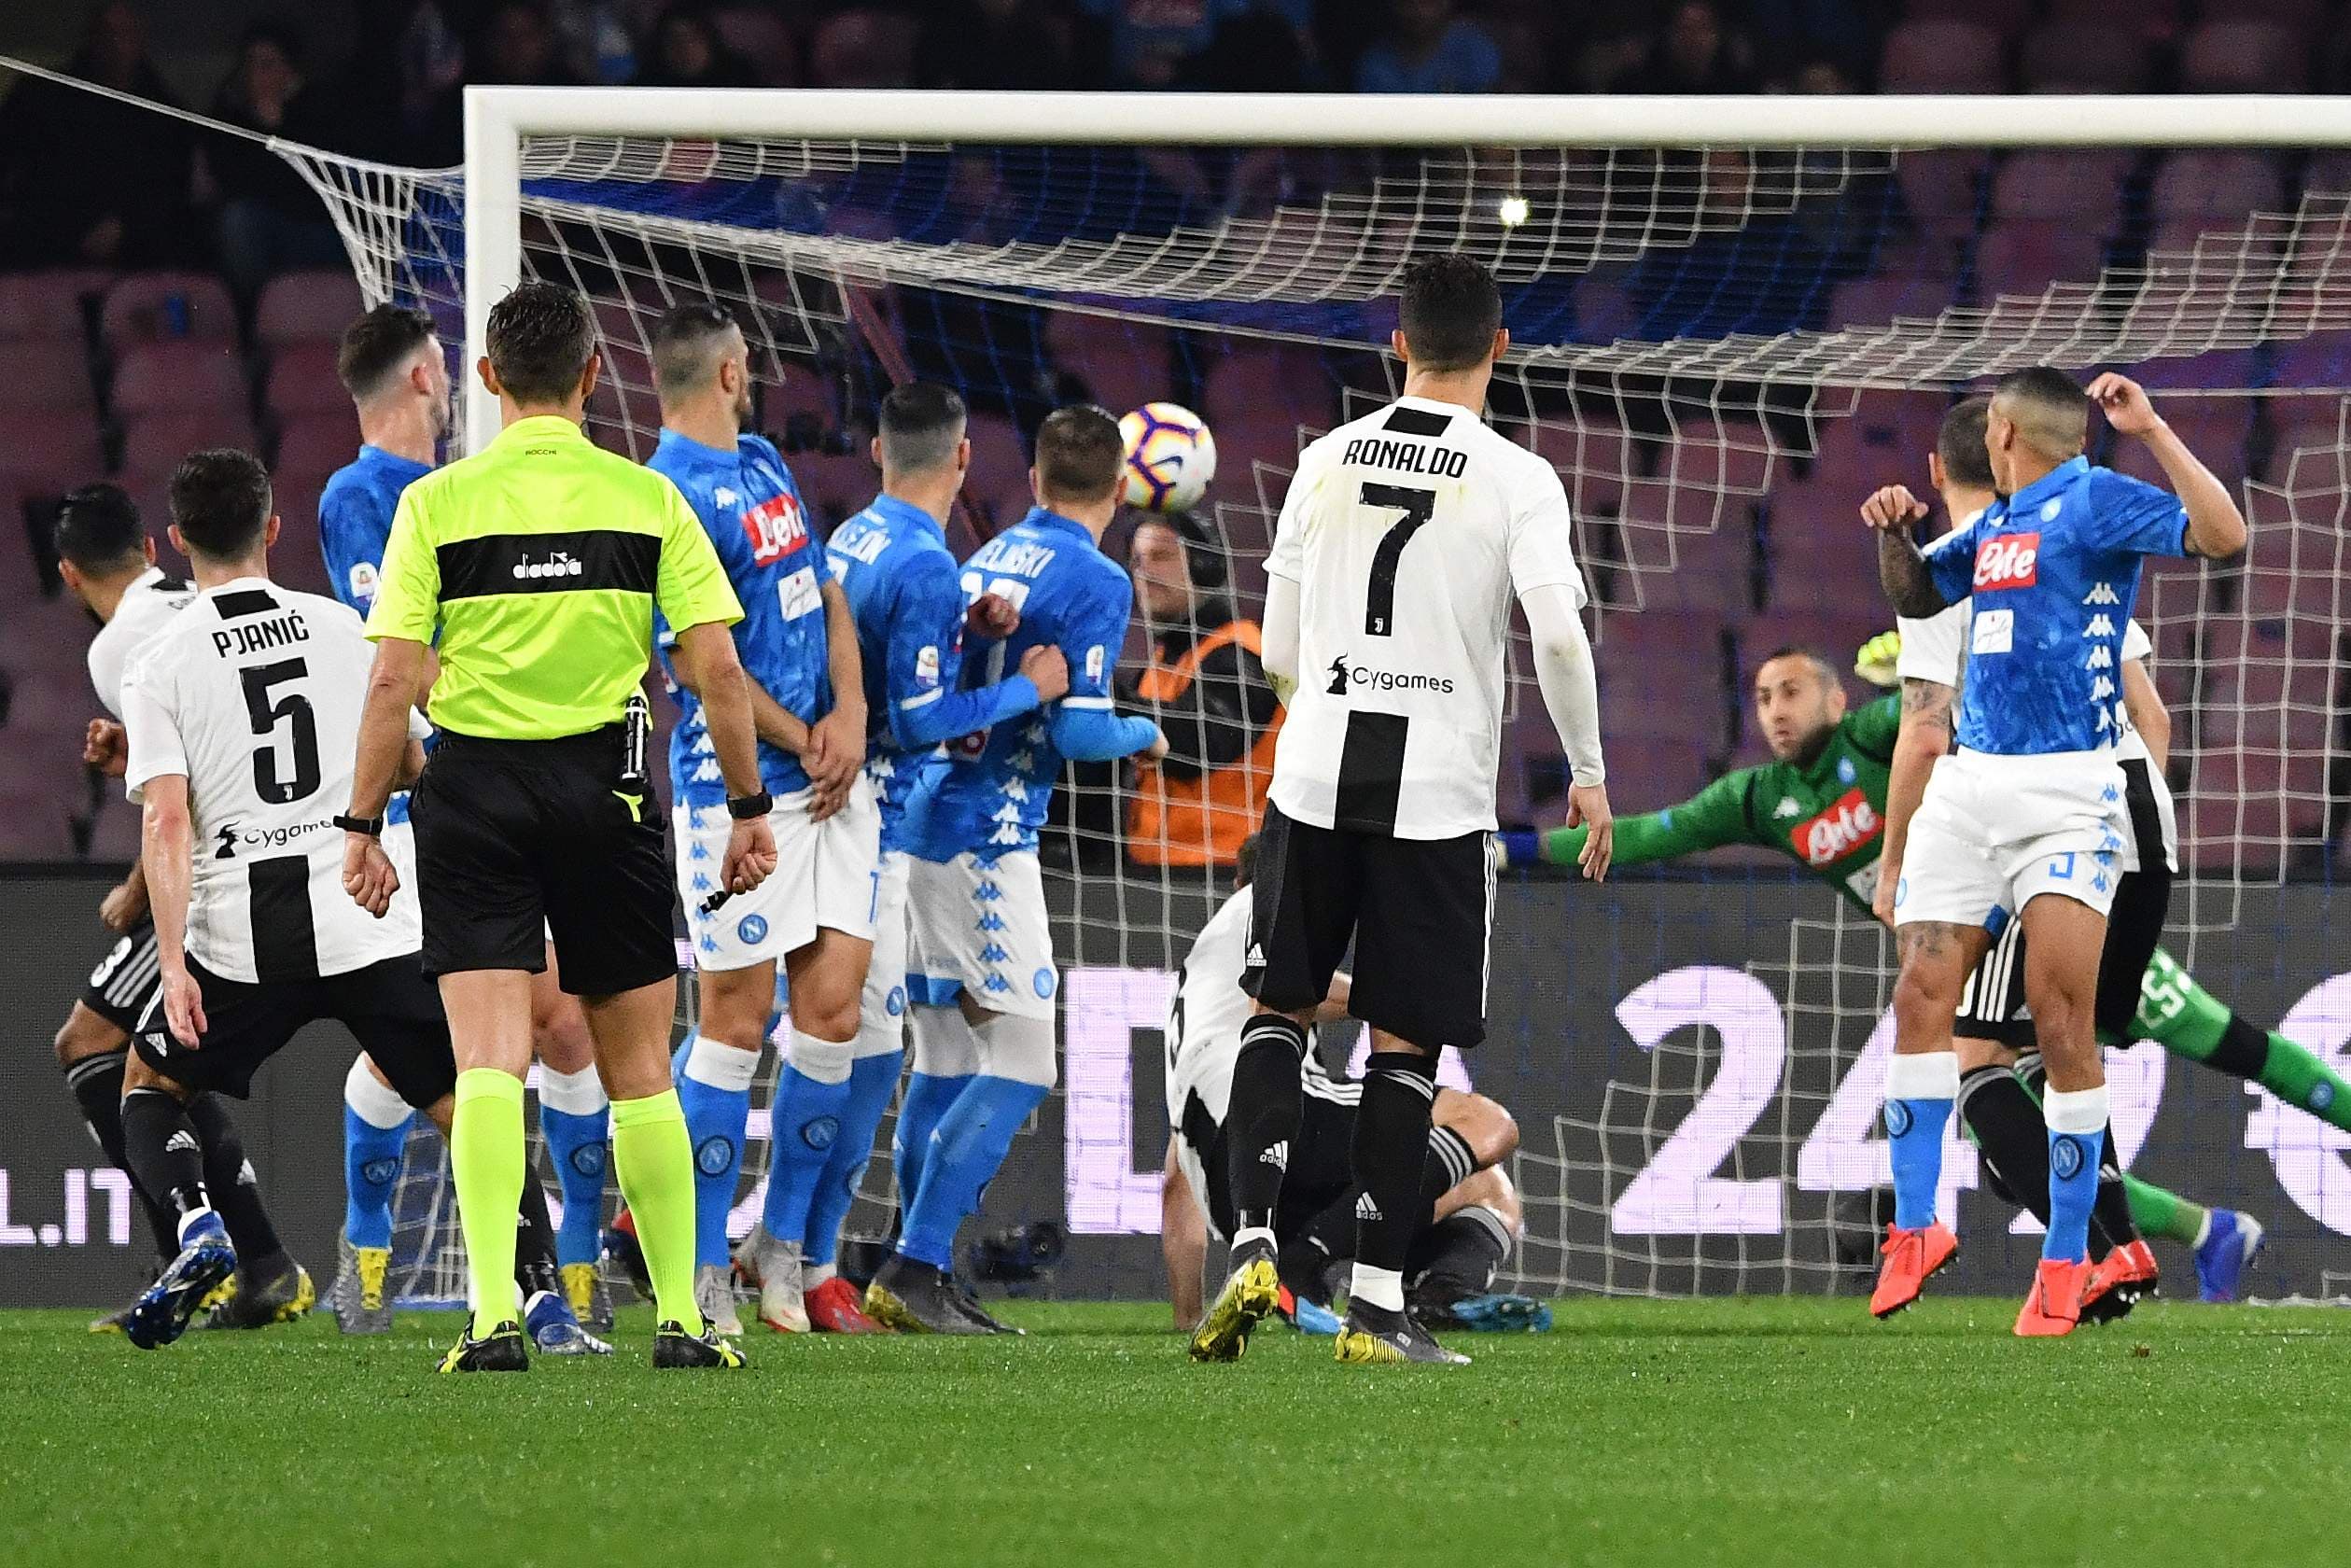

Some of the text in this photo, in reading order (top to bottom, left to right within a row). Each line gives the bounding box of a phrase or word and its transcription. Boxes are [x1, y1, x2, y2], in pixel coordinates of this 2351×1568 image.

[1342, 440, 1468, 478] RONALDO
[512, 552, 582, 579] diadora
[1359, 481, 1436, 637] 7
[211, 609, 310, 658] PJANIĆ
[1351, 666, 1454, 693] Cygames
[238, 656, 321, 805] 5
[245, 819, 334, 848] Cygame
